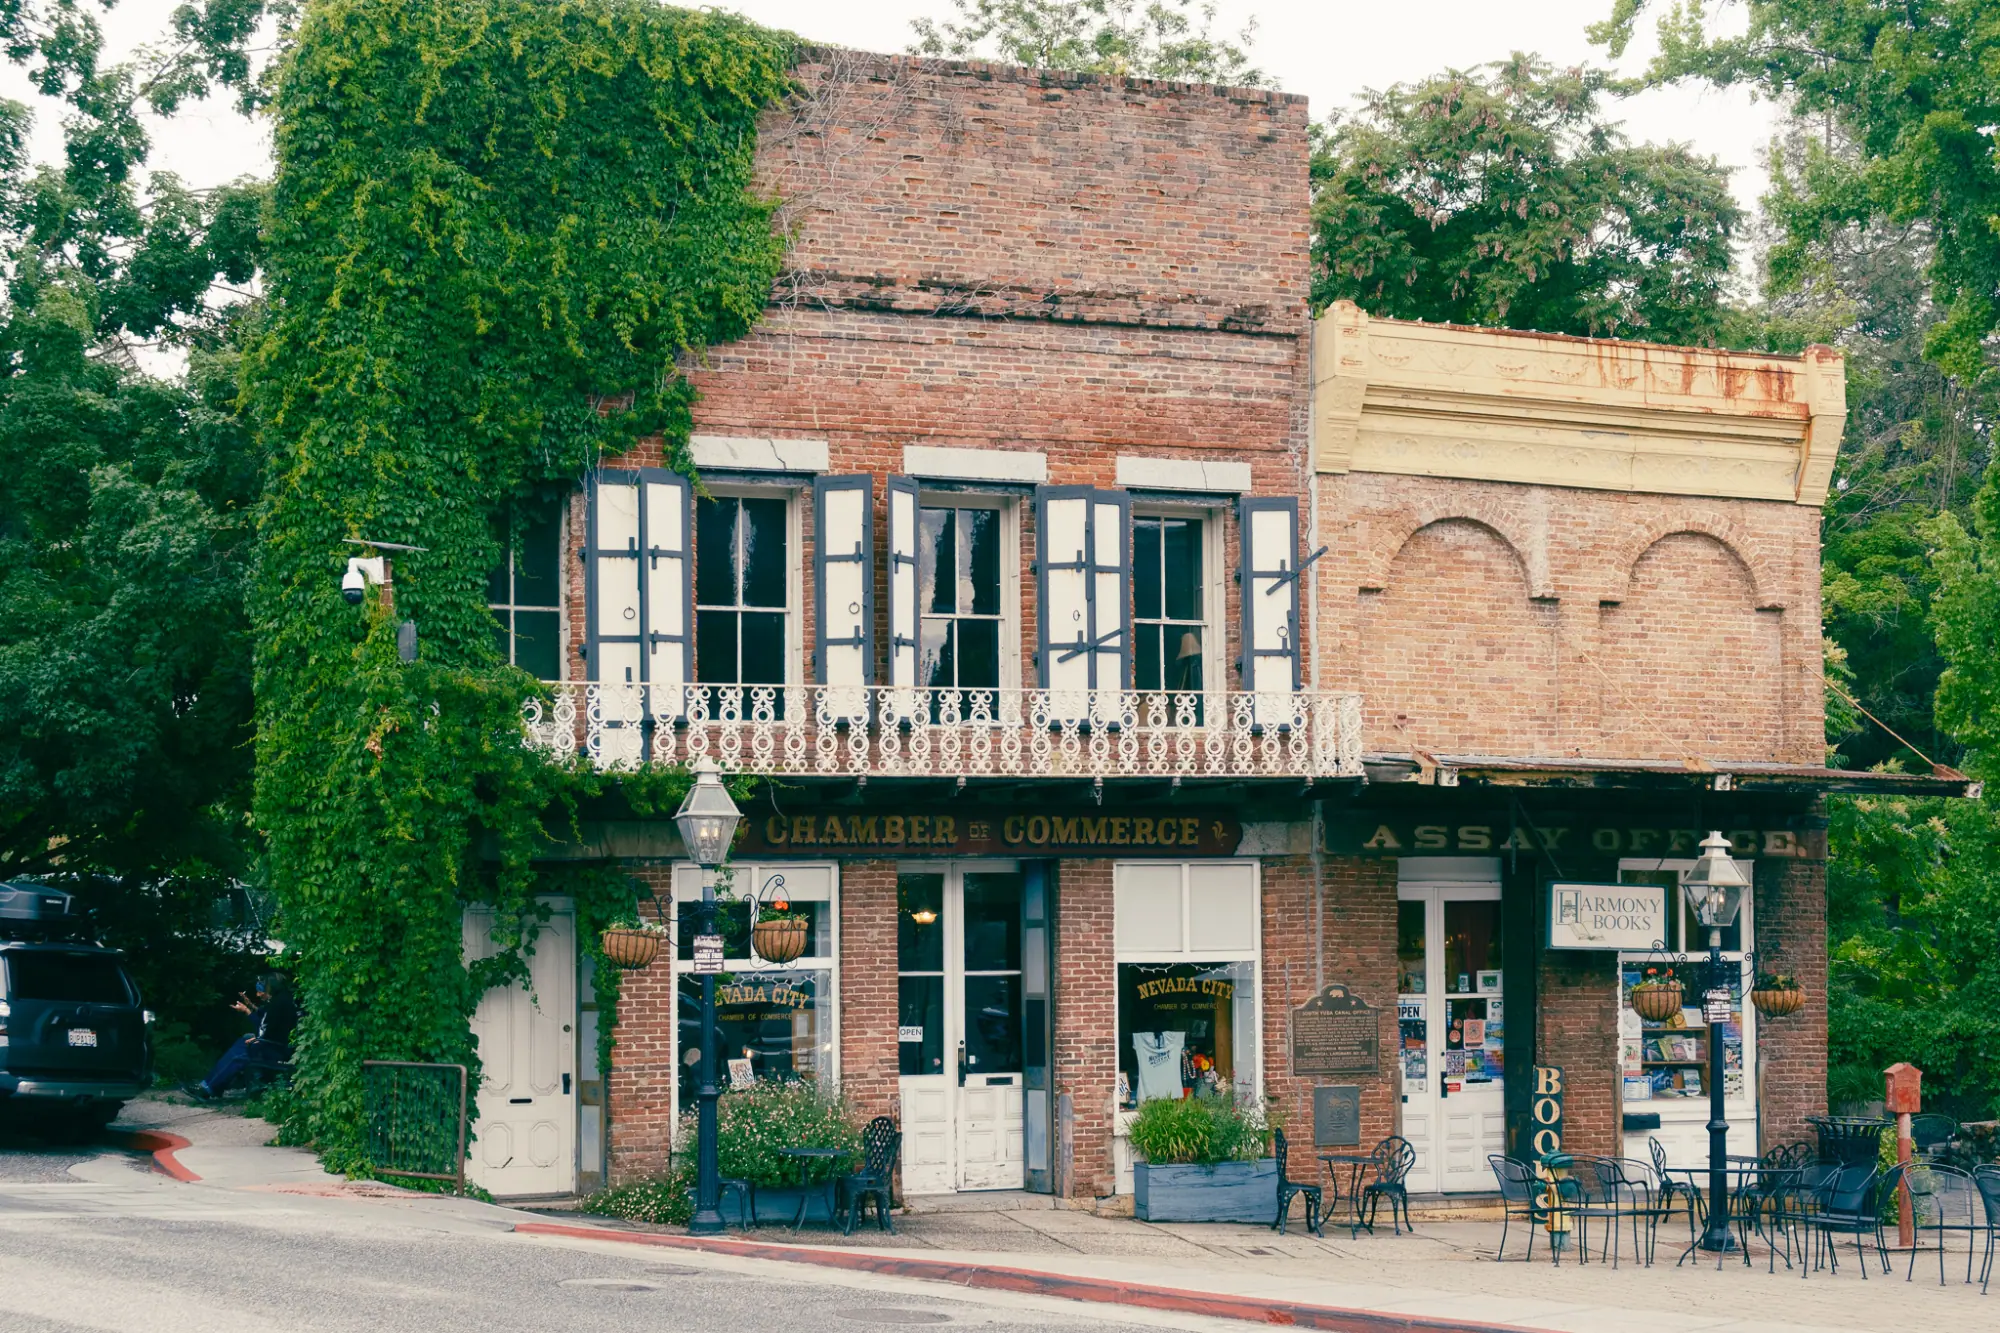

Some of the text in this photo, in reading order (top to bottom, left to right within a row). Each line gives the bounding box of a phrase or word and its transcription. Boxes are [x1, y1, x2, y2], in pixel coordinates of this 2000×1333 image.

[765, 815, 1199, 845] CHAMBER OF COMMERCE
[1362, 825, 1807, 857] ASSAY OFFCE.
[1558, 891, 1661, 924] HARMONY
[1594, 914, 1651, 931] BOOKS
[771, 986, 810, 1010] CITY
[1137, 977, 1235, 1000] NEVADA CITY
[717, 1013, 793, 1021] CHAMBER OF COMMERCE
